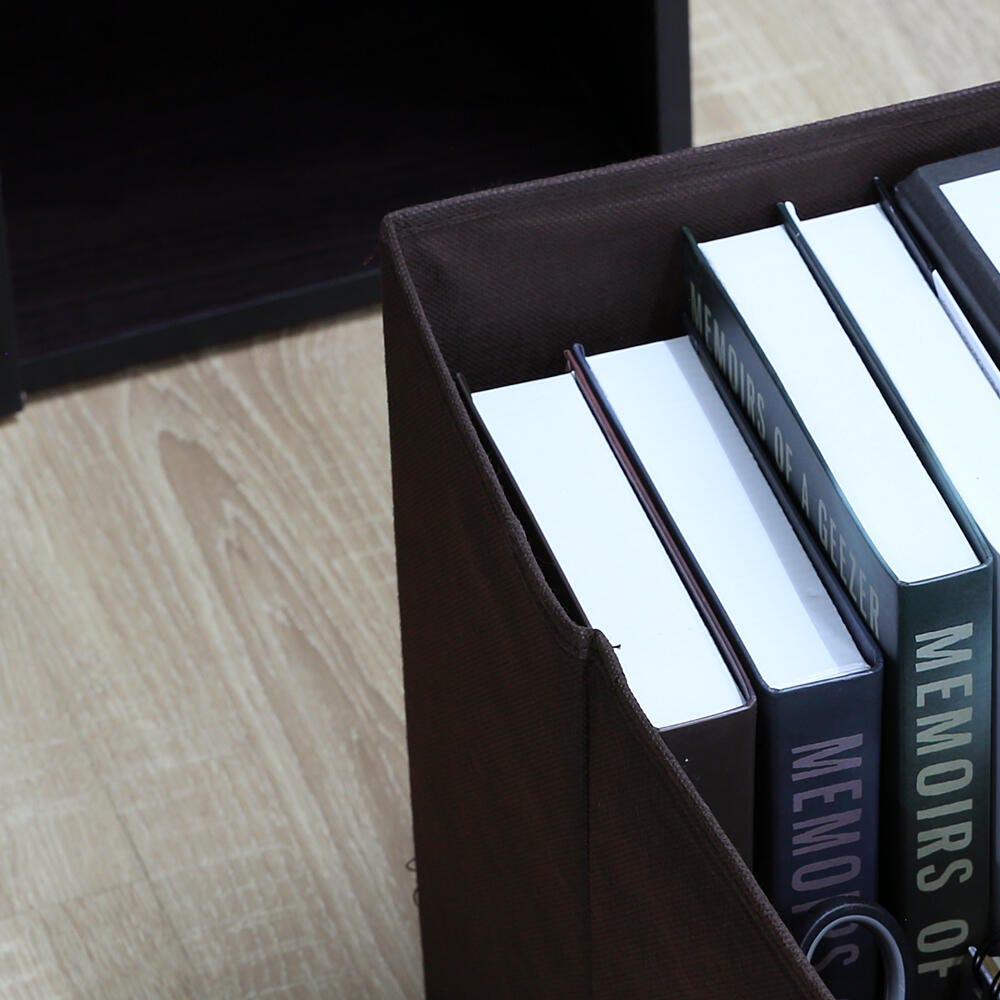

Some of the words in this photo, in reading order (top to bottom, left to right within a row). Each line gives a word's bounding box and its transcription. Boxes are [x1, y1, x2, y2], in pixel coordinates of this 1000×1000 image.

[688, 281, 767, 441] MEMOIRS
[773, 425, 794, 483] OF
[800, 471, 810, 519] A
[817, 499, 880, 641] GEEZER
[914, 622, 974, 893] MEMOIRS
